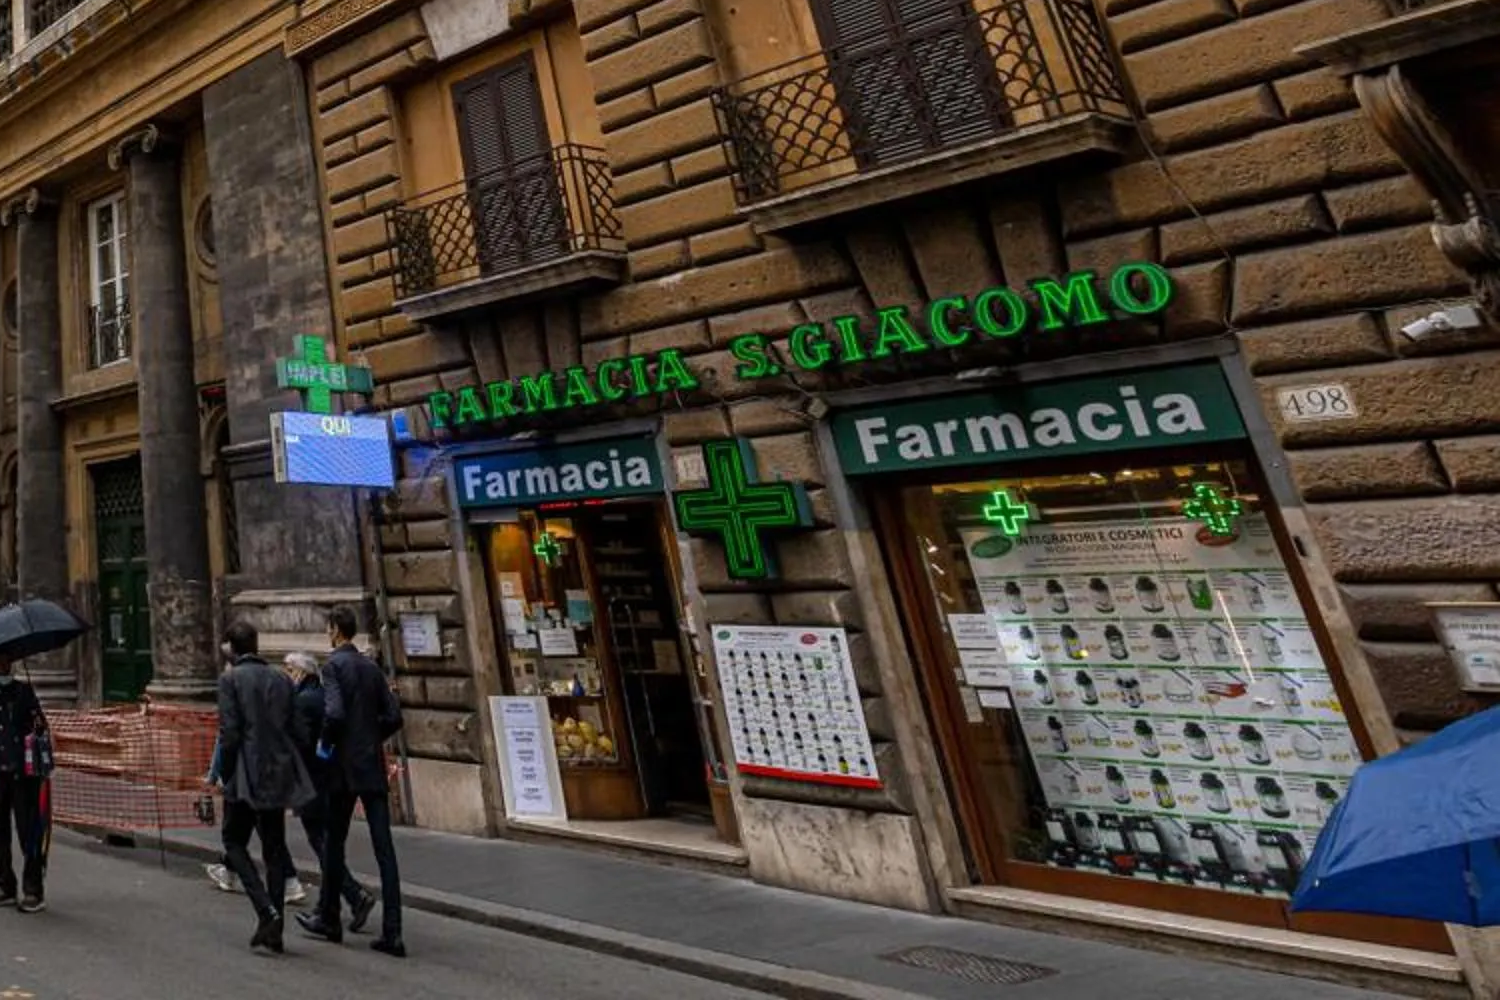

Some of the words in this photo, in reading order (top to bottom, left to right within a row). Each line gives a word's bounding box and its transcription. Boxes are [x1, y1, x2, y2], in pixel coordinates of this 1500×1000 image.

[428, 347, 700, 429] FARMACIA
[1283, 386, 1349, 417] 498
[855, 385, 1206, 465] Farmacia
[462, 448, 652, 502] Farmacia
[1108, 527, 1184, 541] COSMETICI
